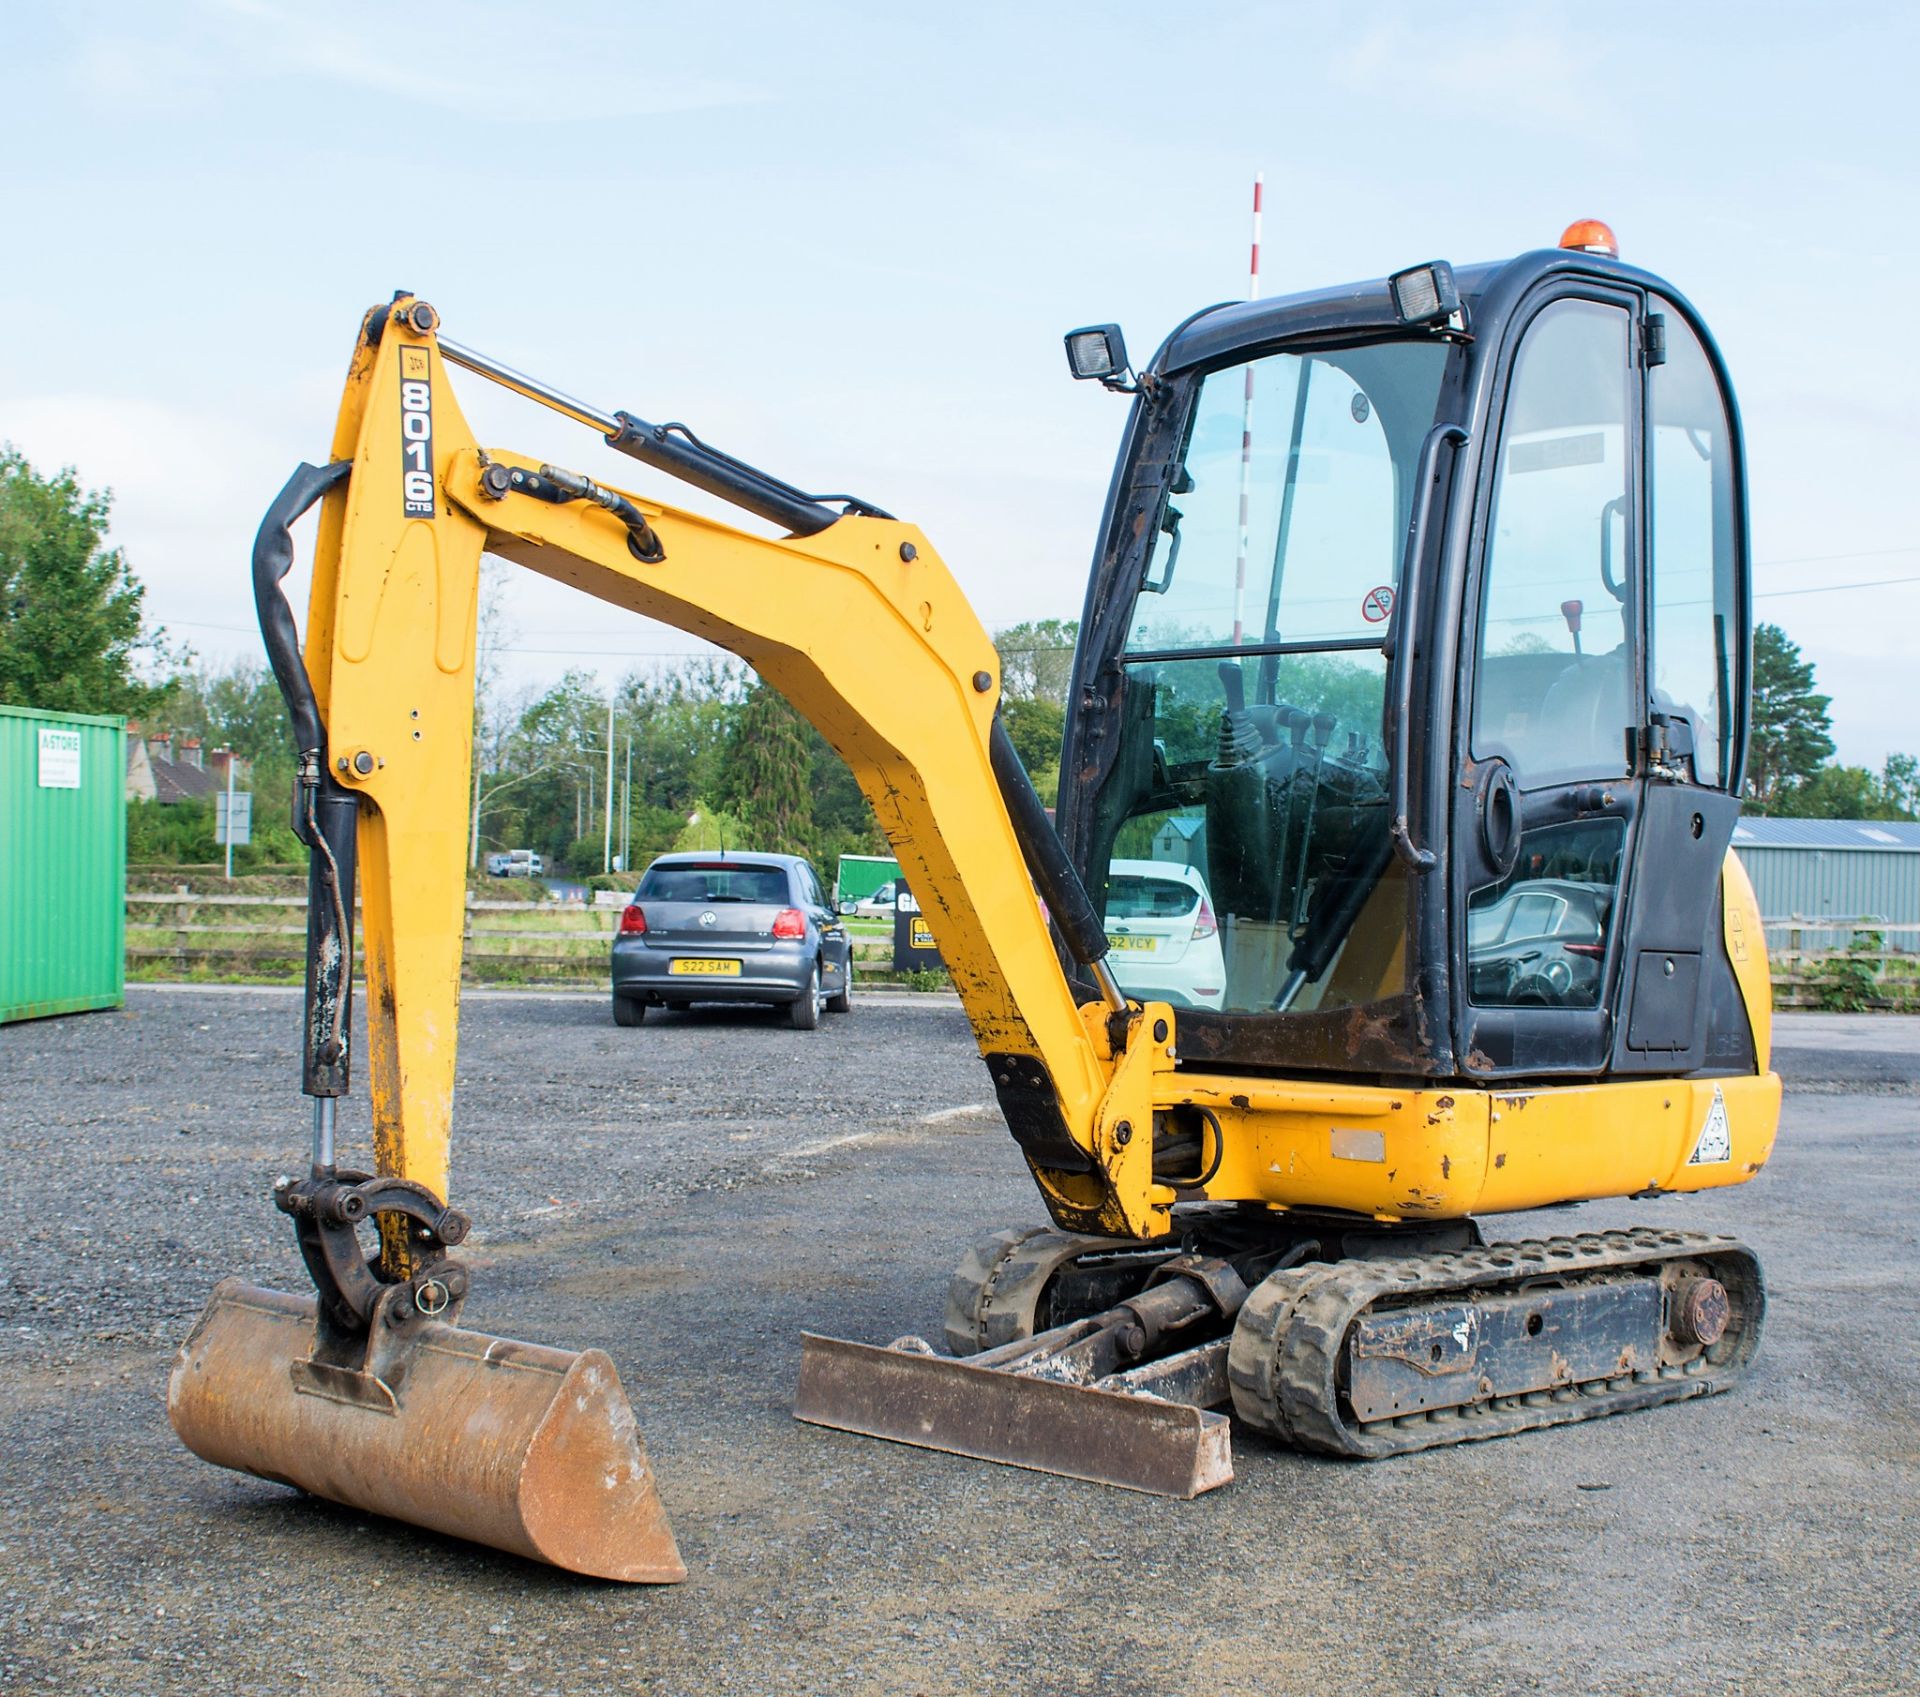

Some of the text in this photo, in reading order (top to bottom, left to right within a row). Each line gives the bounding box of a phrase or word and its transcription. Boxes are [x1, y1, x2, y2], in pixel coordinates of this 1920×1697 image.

[402, 382, 433, 501] 8016
[898, 892, 921, 912] GA
[683, 961, 730, 972] S22 SAM
